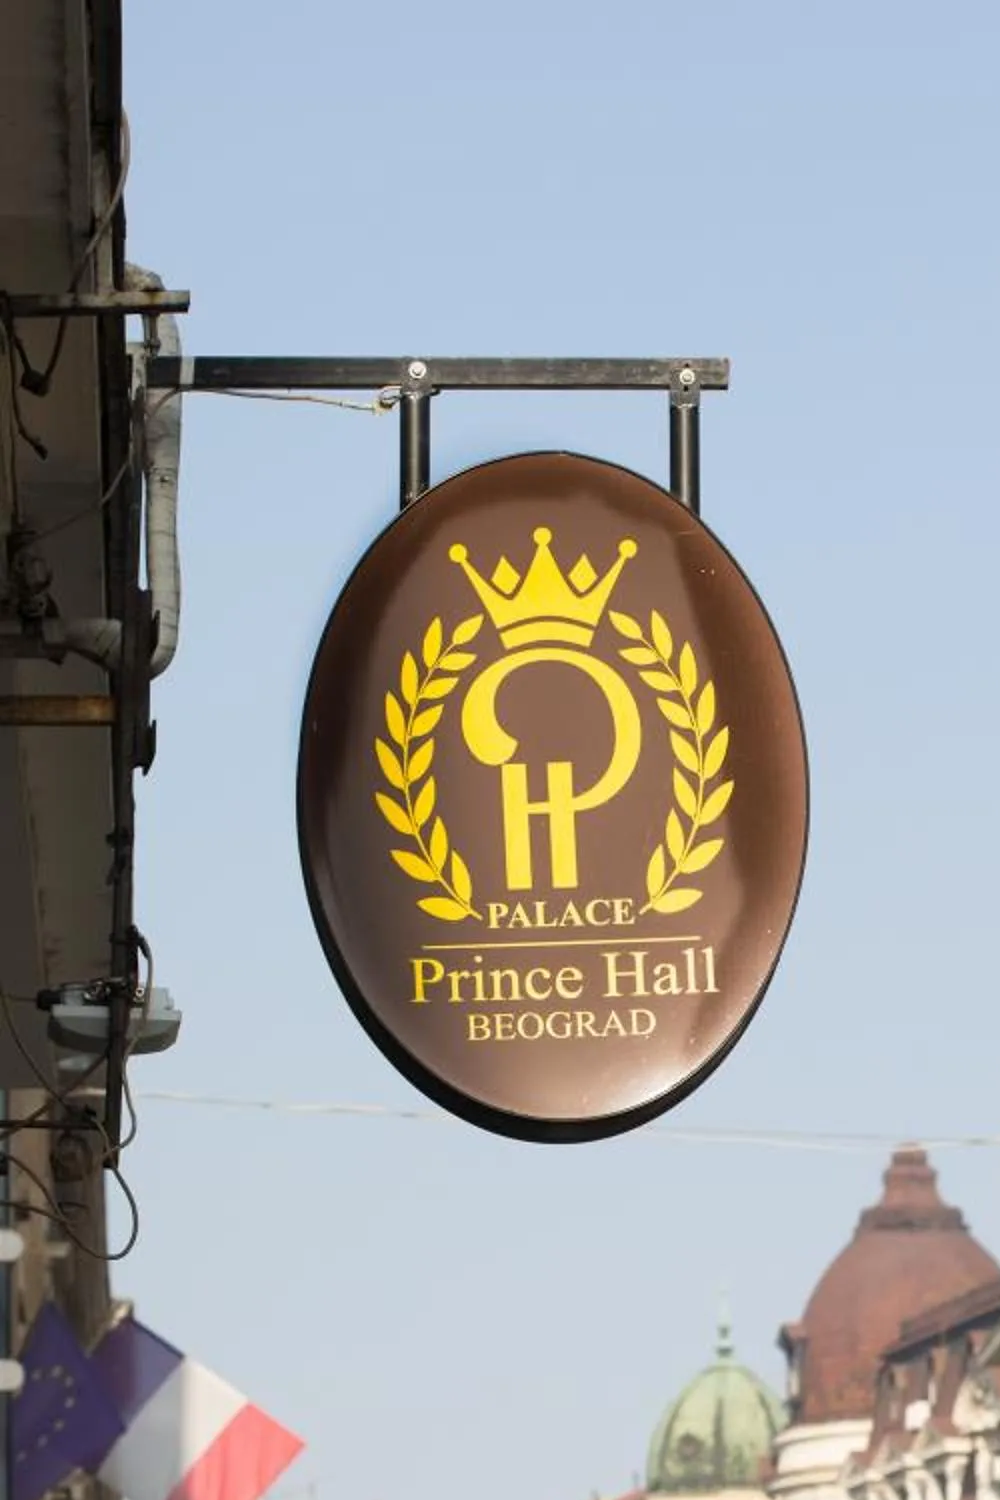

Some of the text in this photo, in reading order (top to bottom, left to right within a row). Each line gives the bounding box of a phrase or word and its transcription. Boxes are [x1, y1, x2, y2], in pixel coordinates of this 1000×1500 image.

[486, 898, 636, 929] PALACE
[409, 946, 721, 1003] Prince Hall
[467, 1008, 657, 1041] BEOGRAD
